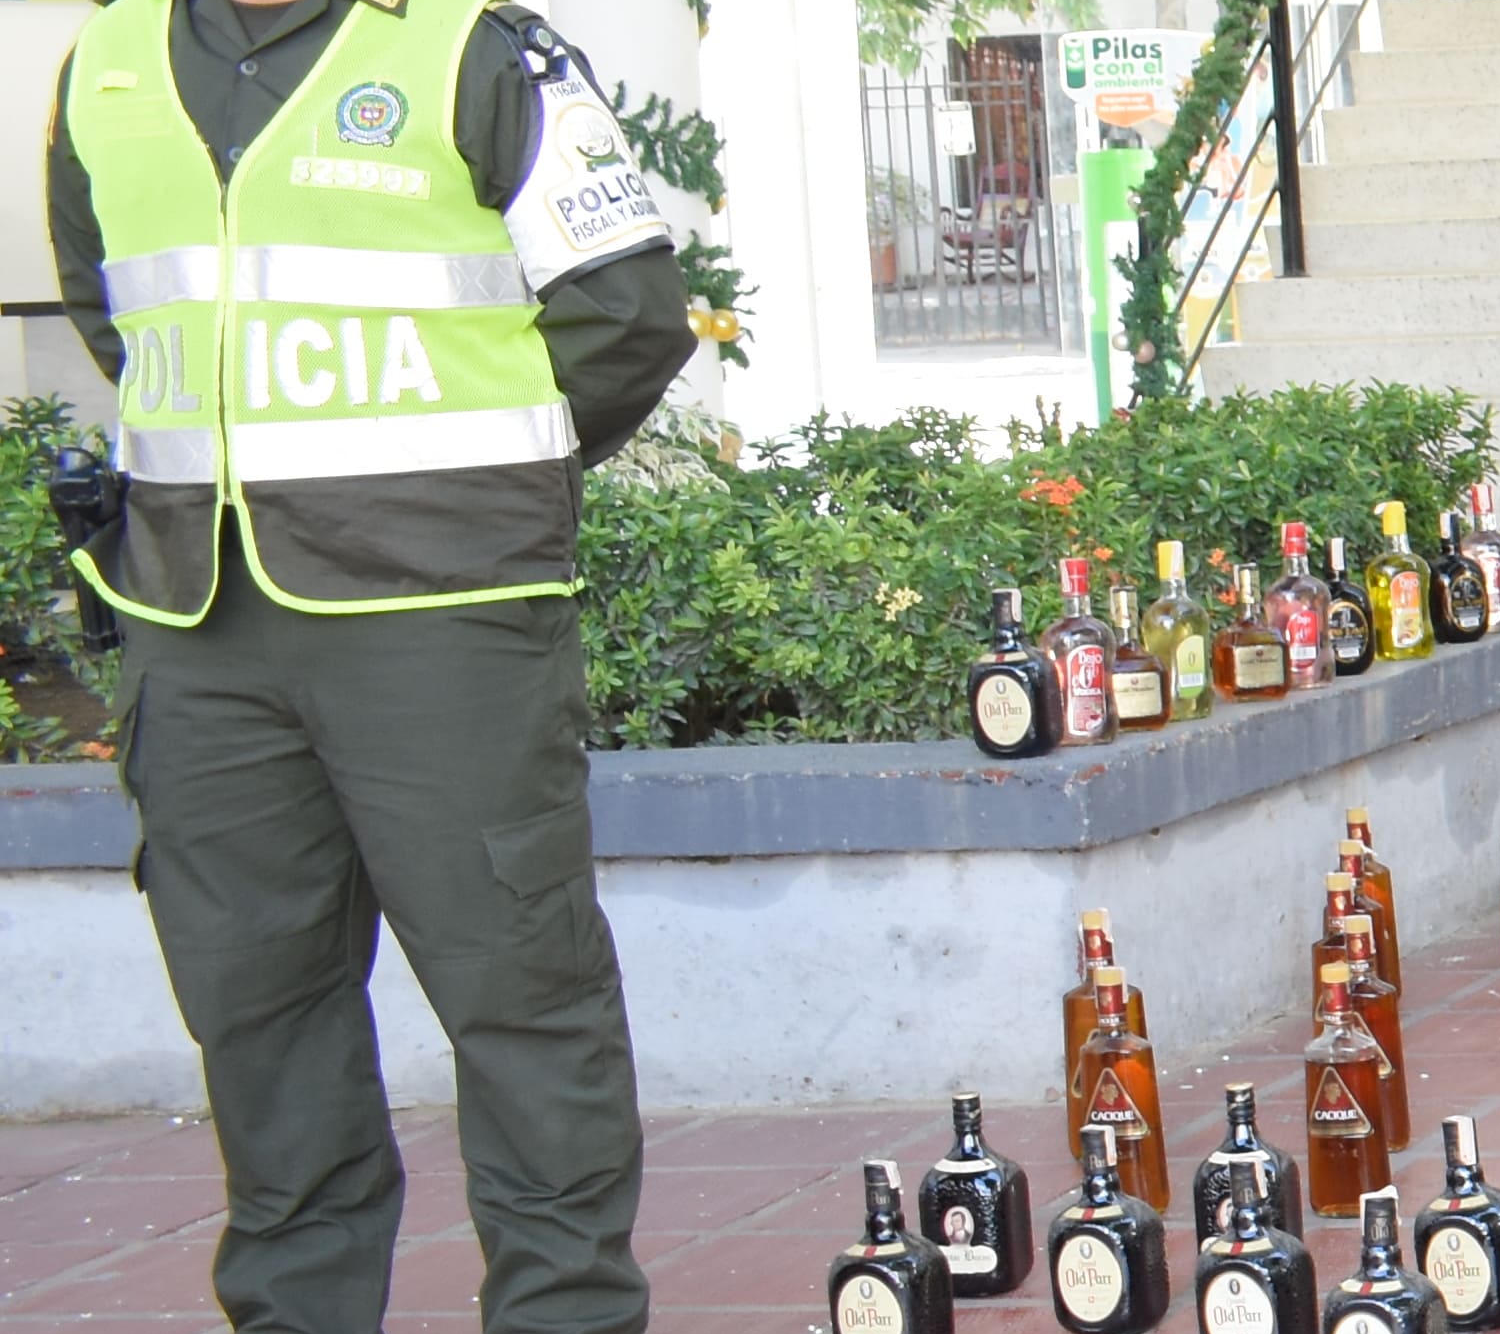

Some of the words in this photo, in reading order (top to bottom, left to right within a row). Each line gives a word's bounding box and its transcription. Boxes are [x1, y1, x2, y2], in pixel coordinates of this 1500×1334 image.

[1092, 36, 1163, 60] Pilas
[1093, 62, 1135, 76] con
[1143, 56, 1164, 75] el
[556, 171, 651, 223] POLICI
[570, 213, 619, 243] FISCAL
[1091, 1109, 1135, 1121] CACIQUE
[1314, 1109, 1358, 1121] CACIQUE
